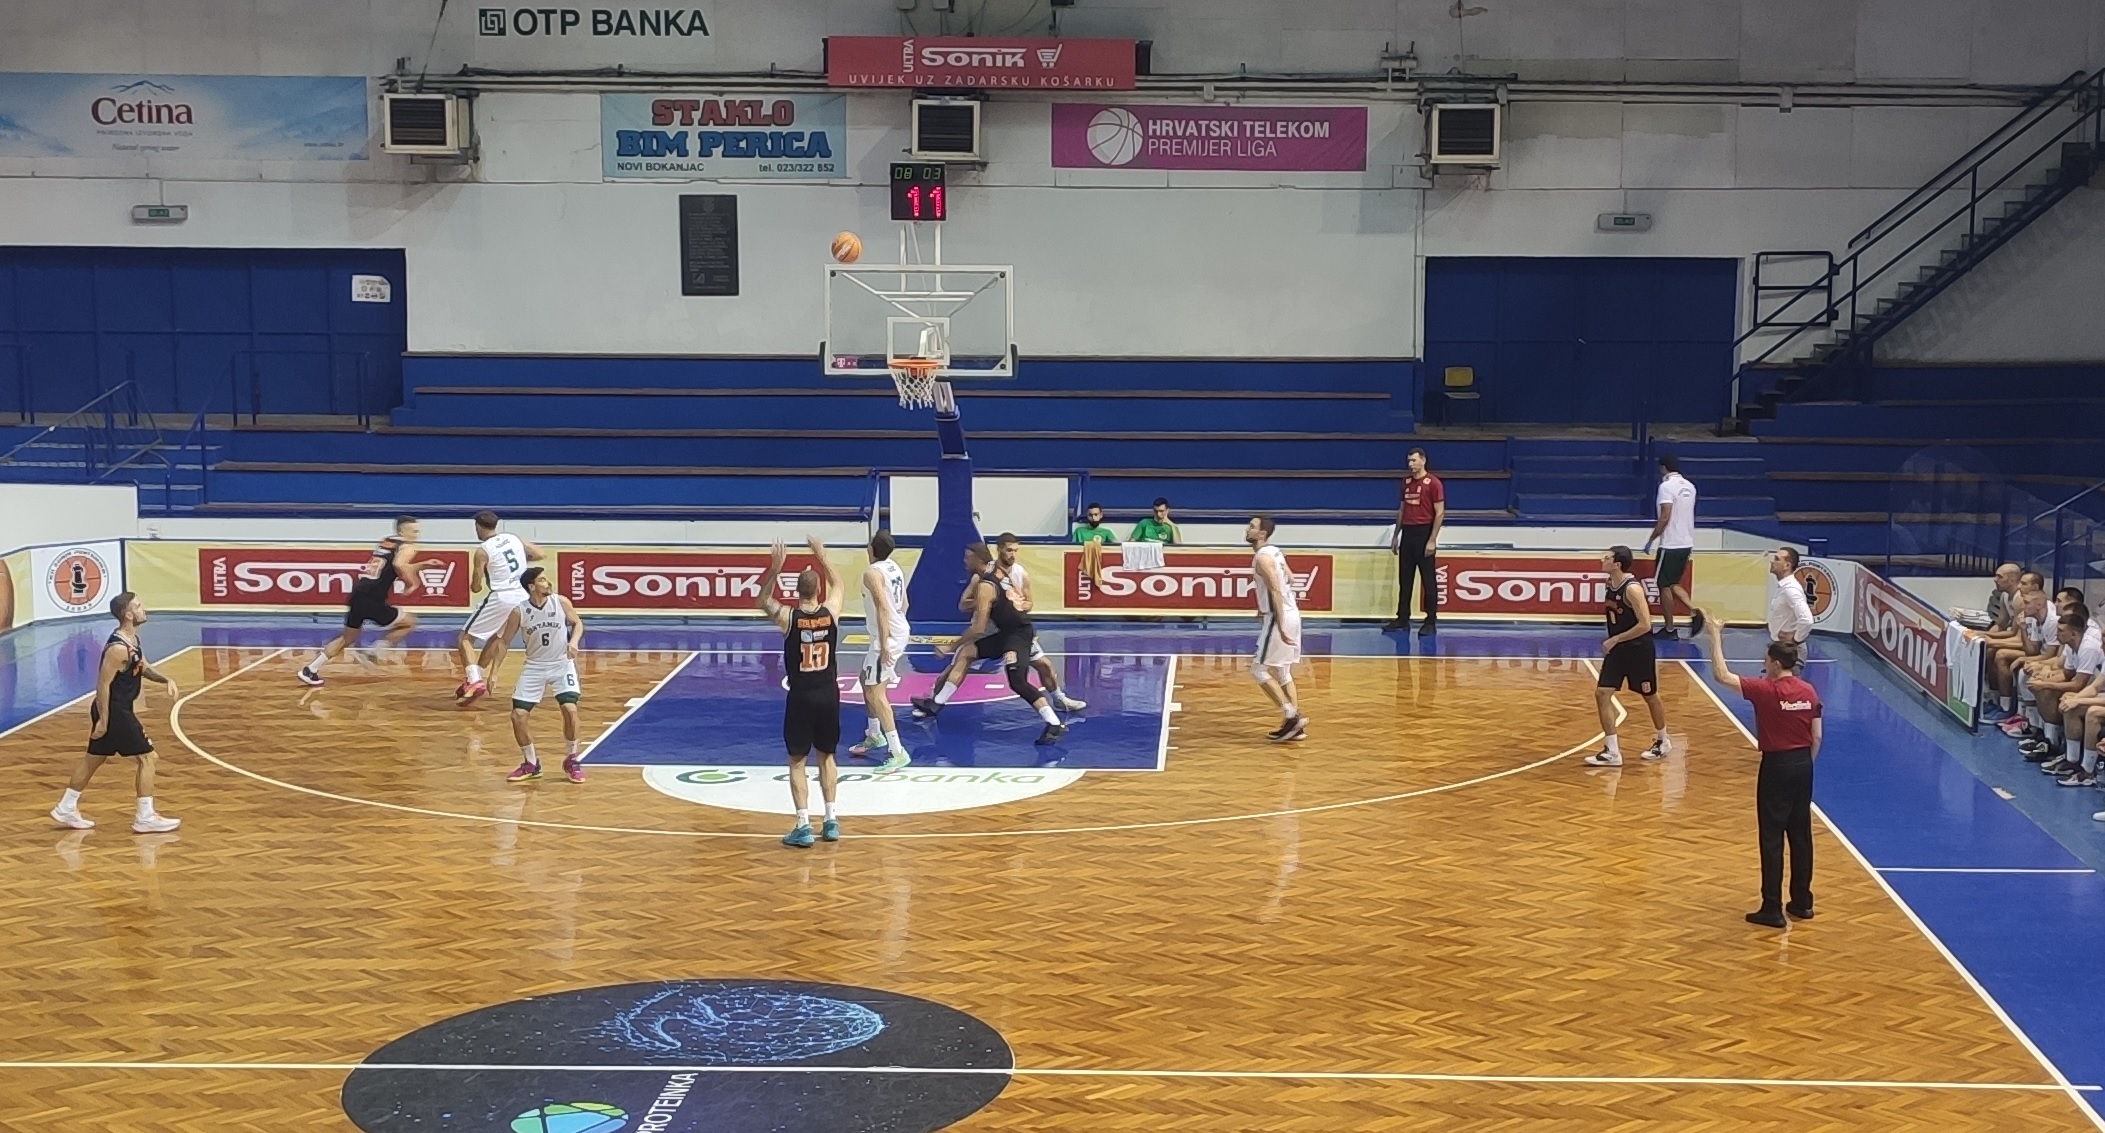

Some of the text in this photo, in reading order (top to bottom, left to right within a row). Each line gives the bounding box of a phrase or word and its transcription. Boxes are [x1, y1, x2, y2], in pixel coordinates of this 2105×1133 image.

[513, 8, 710, 36] OTP BANKA
[902, 39, 914, 73] ULTRA
[921, 47, 1027, 68] Sonik
[849, 74, 1115, 87] UVIJEK UZ ZADARSKU KOŠARKU
[91, 97, 194, 125] Cetina
[652, 100, 795, 126] STAKLO
[1148, 119, 1330, 139] HRVATSKI TELEKOM
[616, 130, 833, 159] BIM PERICA
[1148, 138, 1278, 157] PREMIJER LIGA
[617, 162, 643, 172] NOVI
[648, 162, 705, 172] BOKANJAC
[759, 163, 775, 173] tel.
[777, 163, 815, 173] 023/322
[894, 166, 942, 180] 08 03
[502, 548, 520, 574] 5
[213, 556, 228, 598] ULTRA
[571, 560, 586, 601] ULTRA
[592, 565, 767, 598] Sonik
[541, 632, 550, 646] 6
[566, 673, 575, 687] 6
